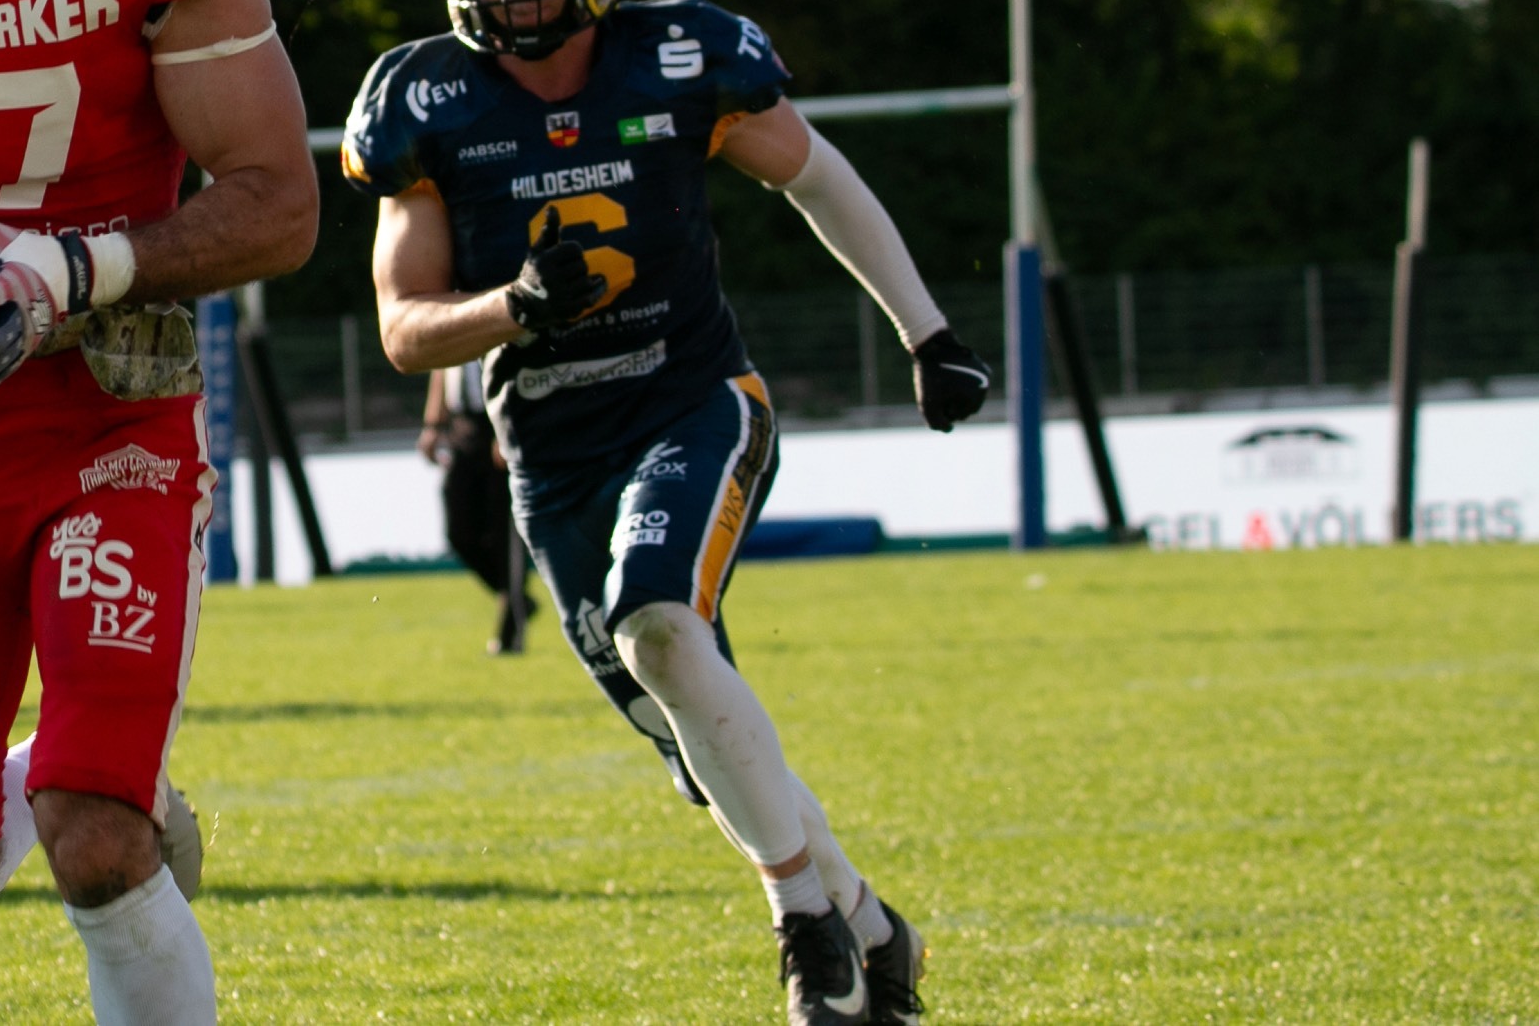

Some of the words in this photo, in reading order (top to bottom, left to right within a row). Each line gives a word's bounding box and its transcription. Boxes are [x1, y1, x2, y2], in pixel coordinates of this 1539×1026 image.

[430, 78, 468, 105] EVI
[458, 140, 518, 161] PABSCH
[511, 159, 635, 200] HILDESHEIM
[528, 192, 636, 322] 6
[50, 511, 103, 560] yes
[1281, 496, 1522, 547] VÖLERS
[58, 539, 134, 601] BS
[136, 584, 158, 608] by
[88, 600, 156, 646] BZ
